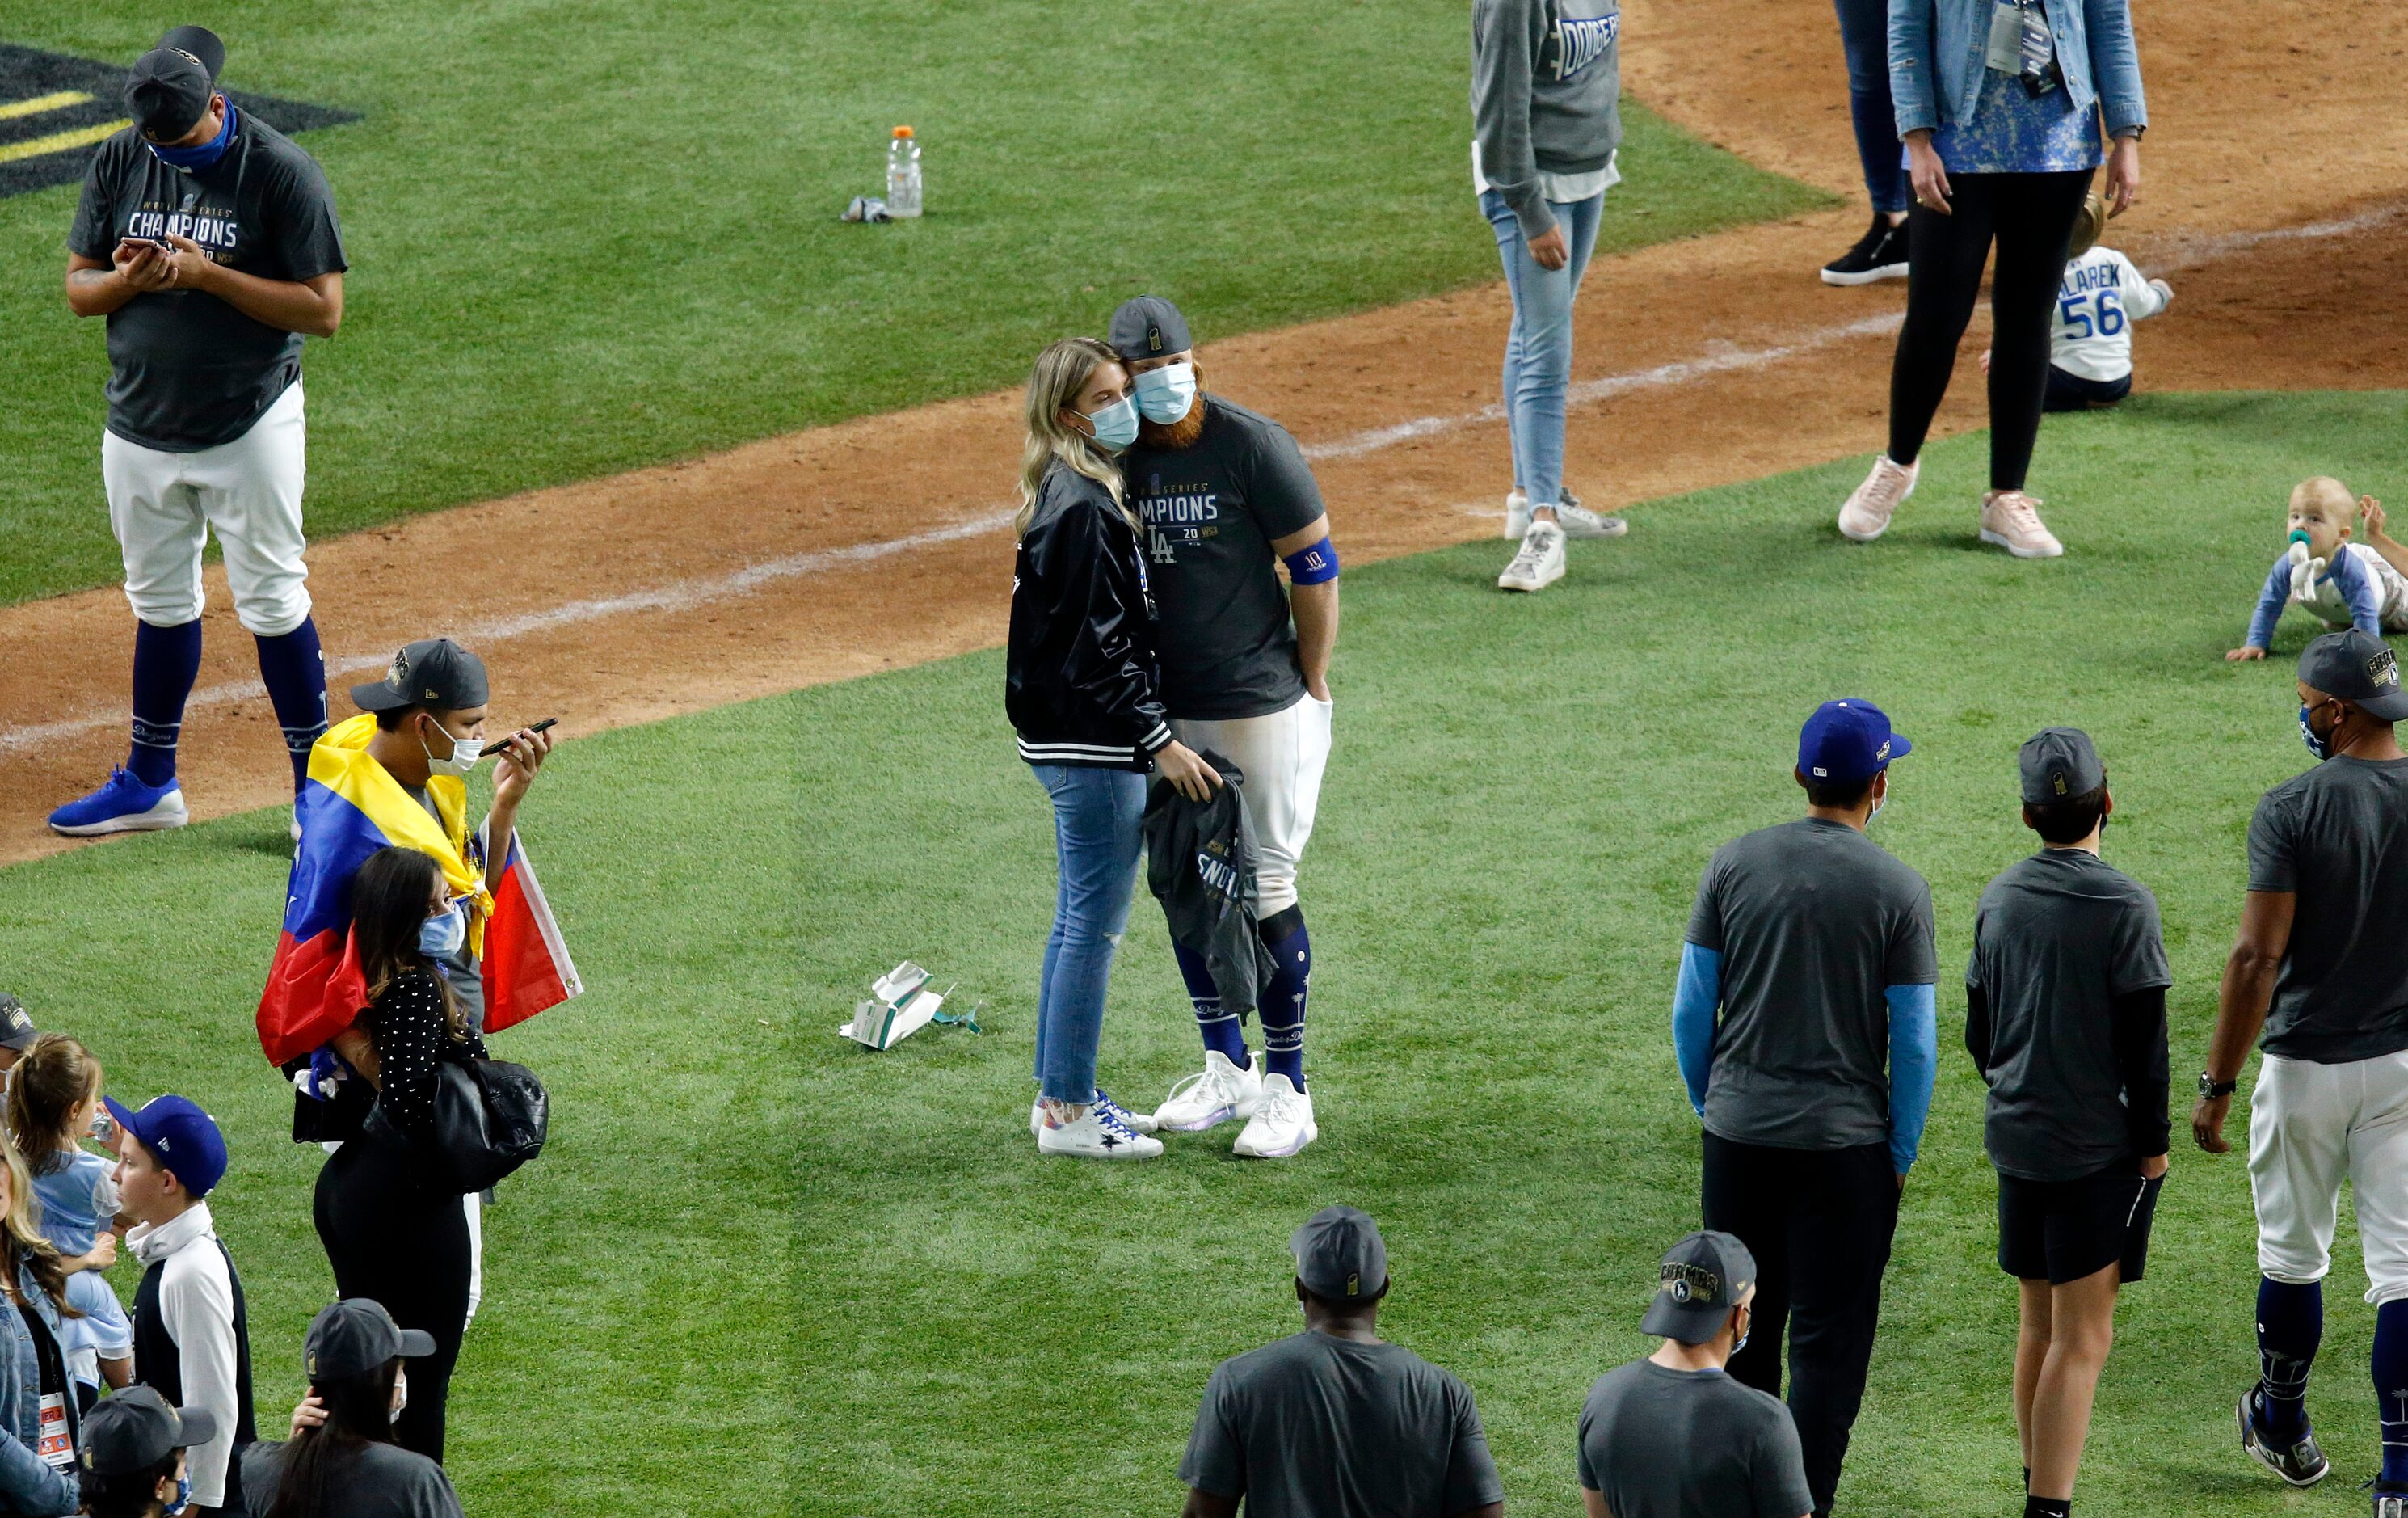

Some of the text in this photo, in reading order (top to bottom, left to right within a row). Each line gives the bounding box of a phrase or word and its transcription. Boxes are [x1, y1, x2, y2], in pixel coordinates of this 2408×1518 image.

[128, 212, 238, 247] CHAMPIONS
[2058, 264, 2120, 298] LAREK
[2061, 290, 2124, 339] 56
[1139, 495, 1218, 523] MPIONS
[1147, 525, 1177, 563] LA
[1183, 528, 1198, 539] 20
[1305, 551, 1322, 567] 10
[1661, 1262, 1718, 1292] CHAMPS
